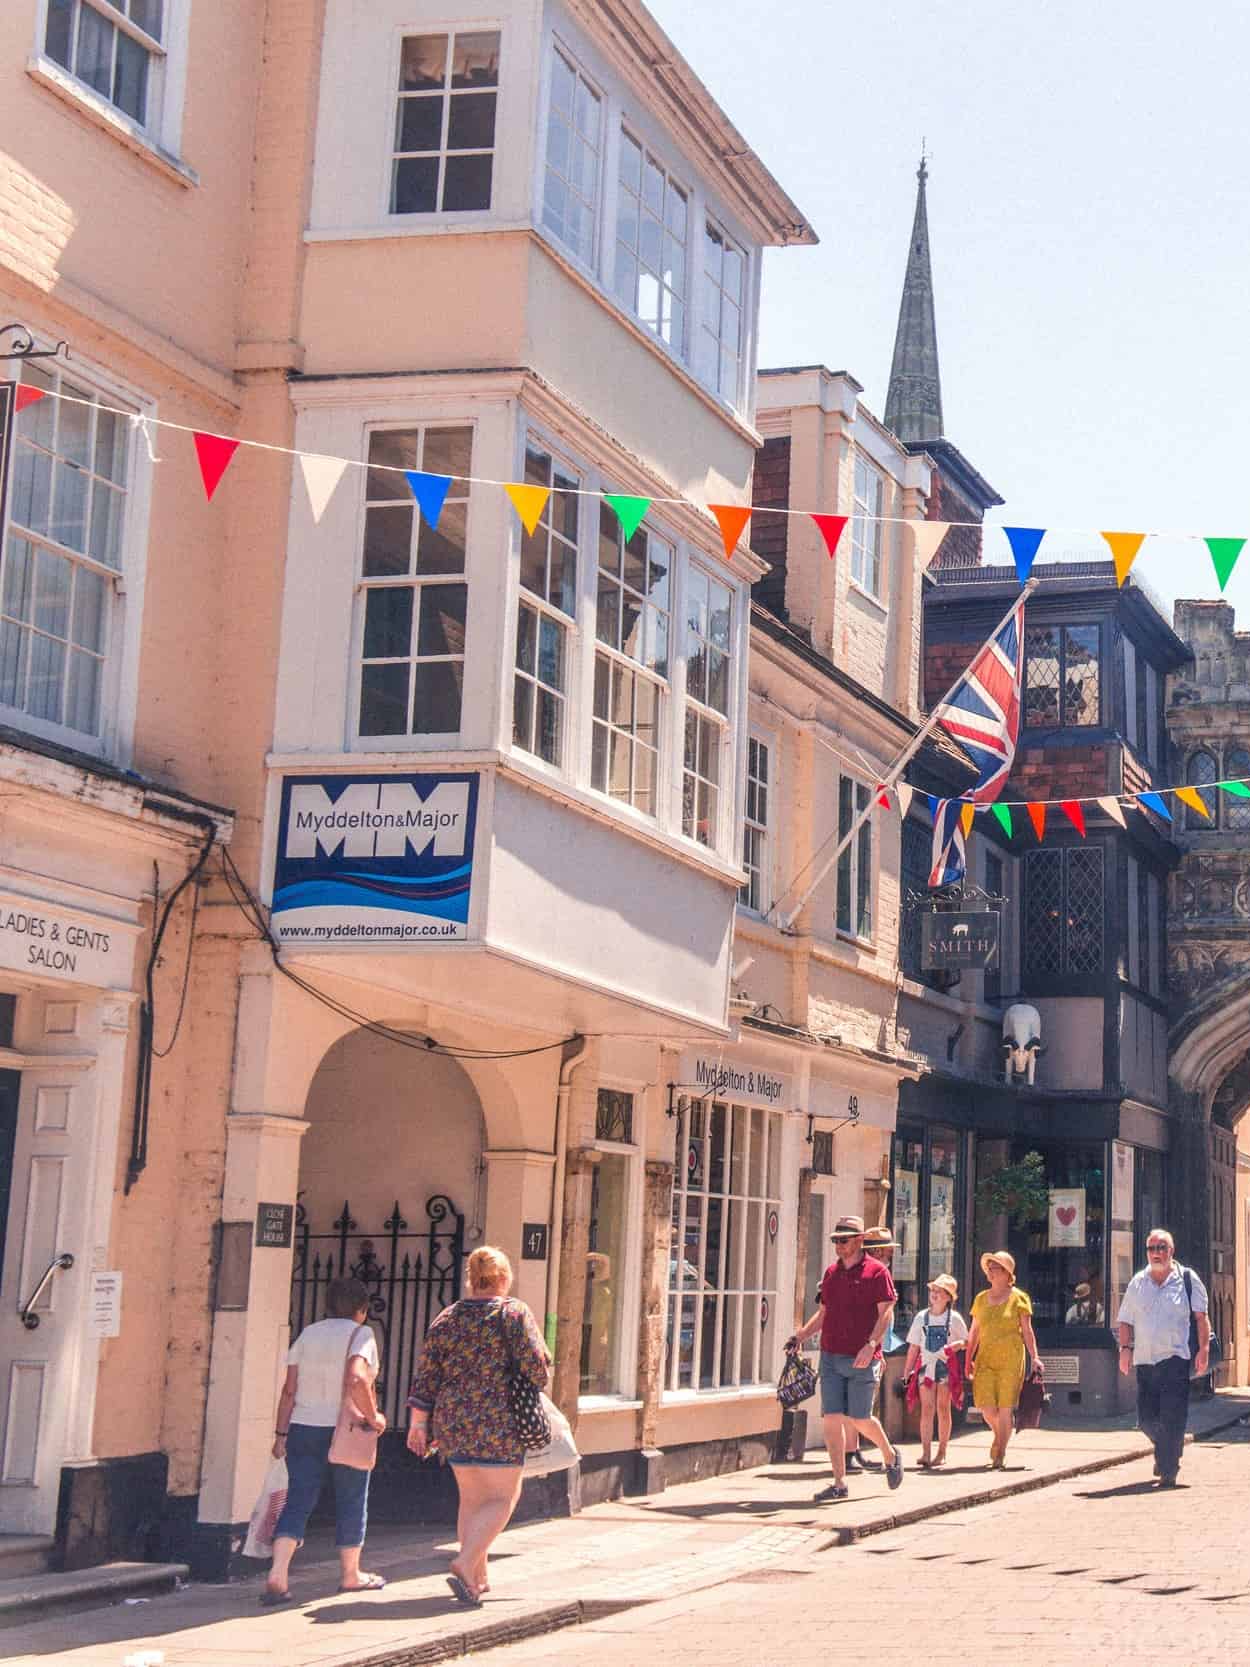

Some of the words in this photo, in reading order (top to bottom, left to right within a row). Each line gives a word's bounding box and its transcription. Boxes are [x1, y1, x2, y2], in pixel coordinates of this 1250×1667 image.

[296, 809, 460, 833] Myddelton&Major
[0, 908, 46, 938] LADIES
[50, 922, 60, 941] &
[66, 926, 110, 953] GENTS
[279, 923, 457, 939] www.myddeltonmajor.co.uk
[27, 944, 77, 972] SALON
[928, 940, 988, 953] SMITH
[696, 1059, 745, 1092] Myddelton
[748, 1072, 754, 1093] &
[757, 1073, 783, 1103] Major
[848, 1095, 859, 1116] 49
[528, 1232, 542, 1254] 47
